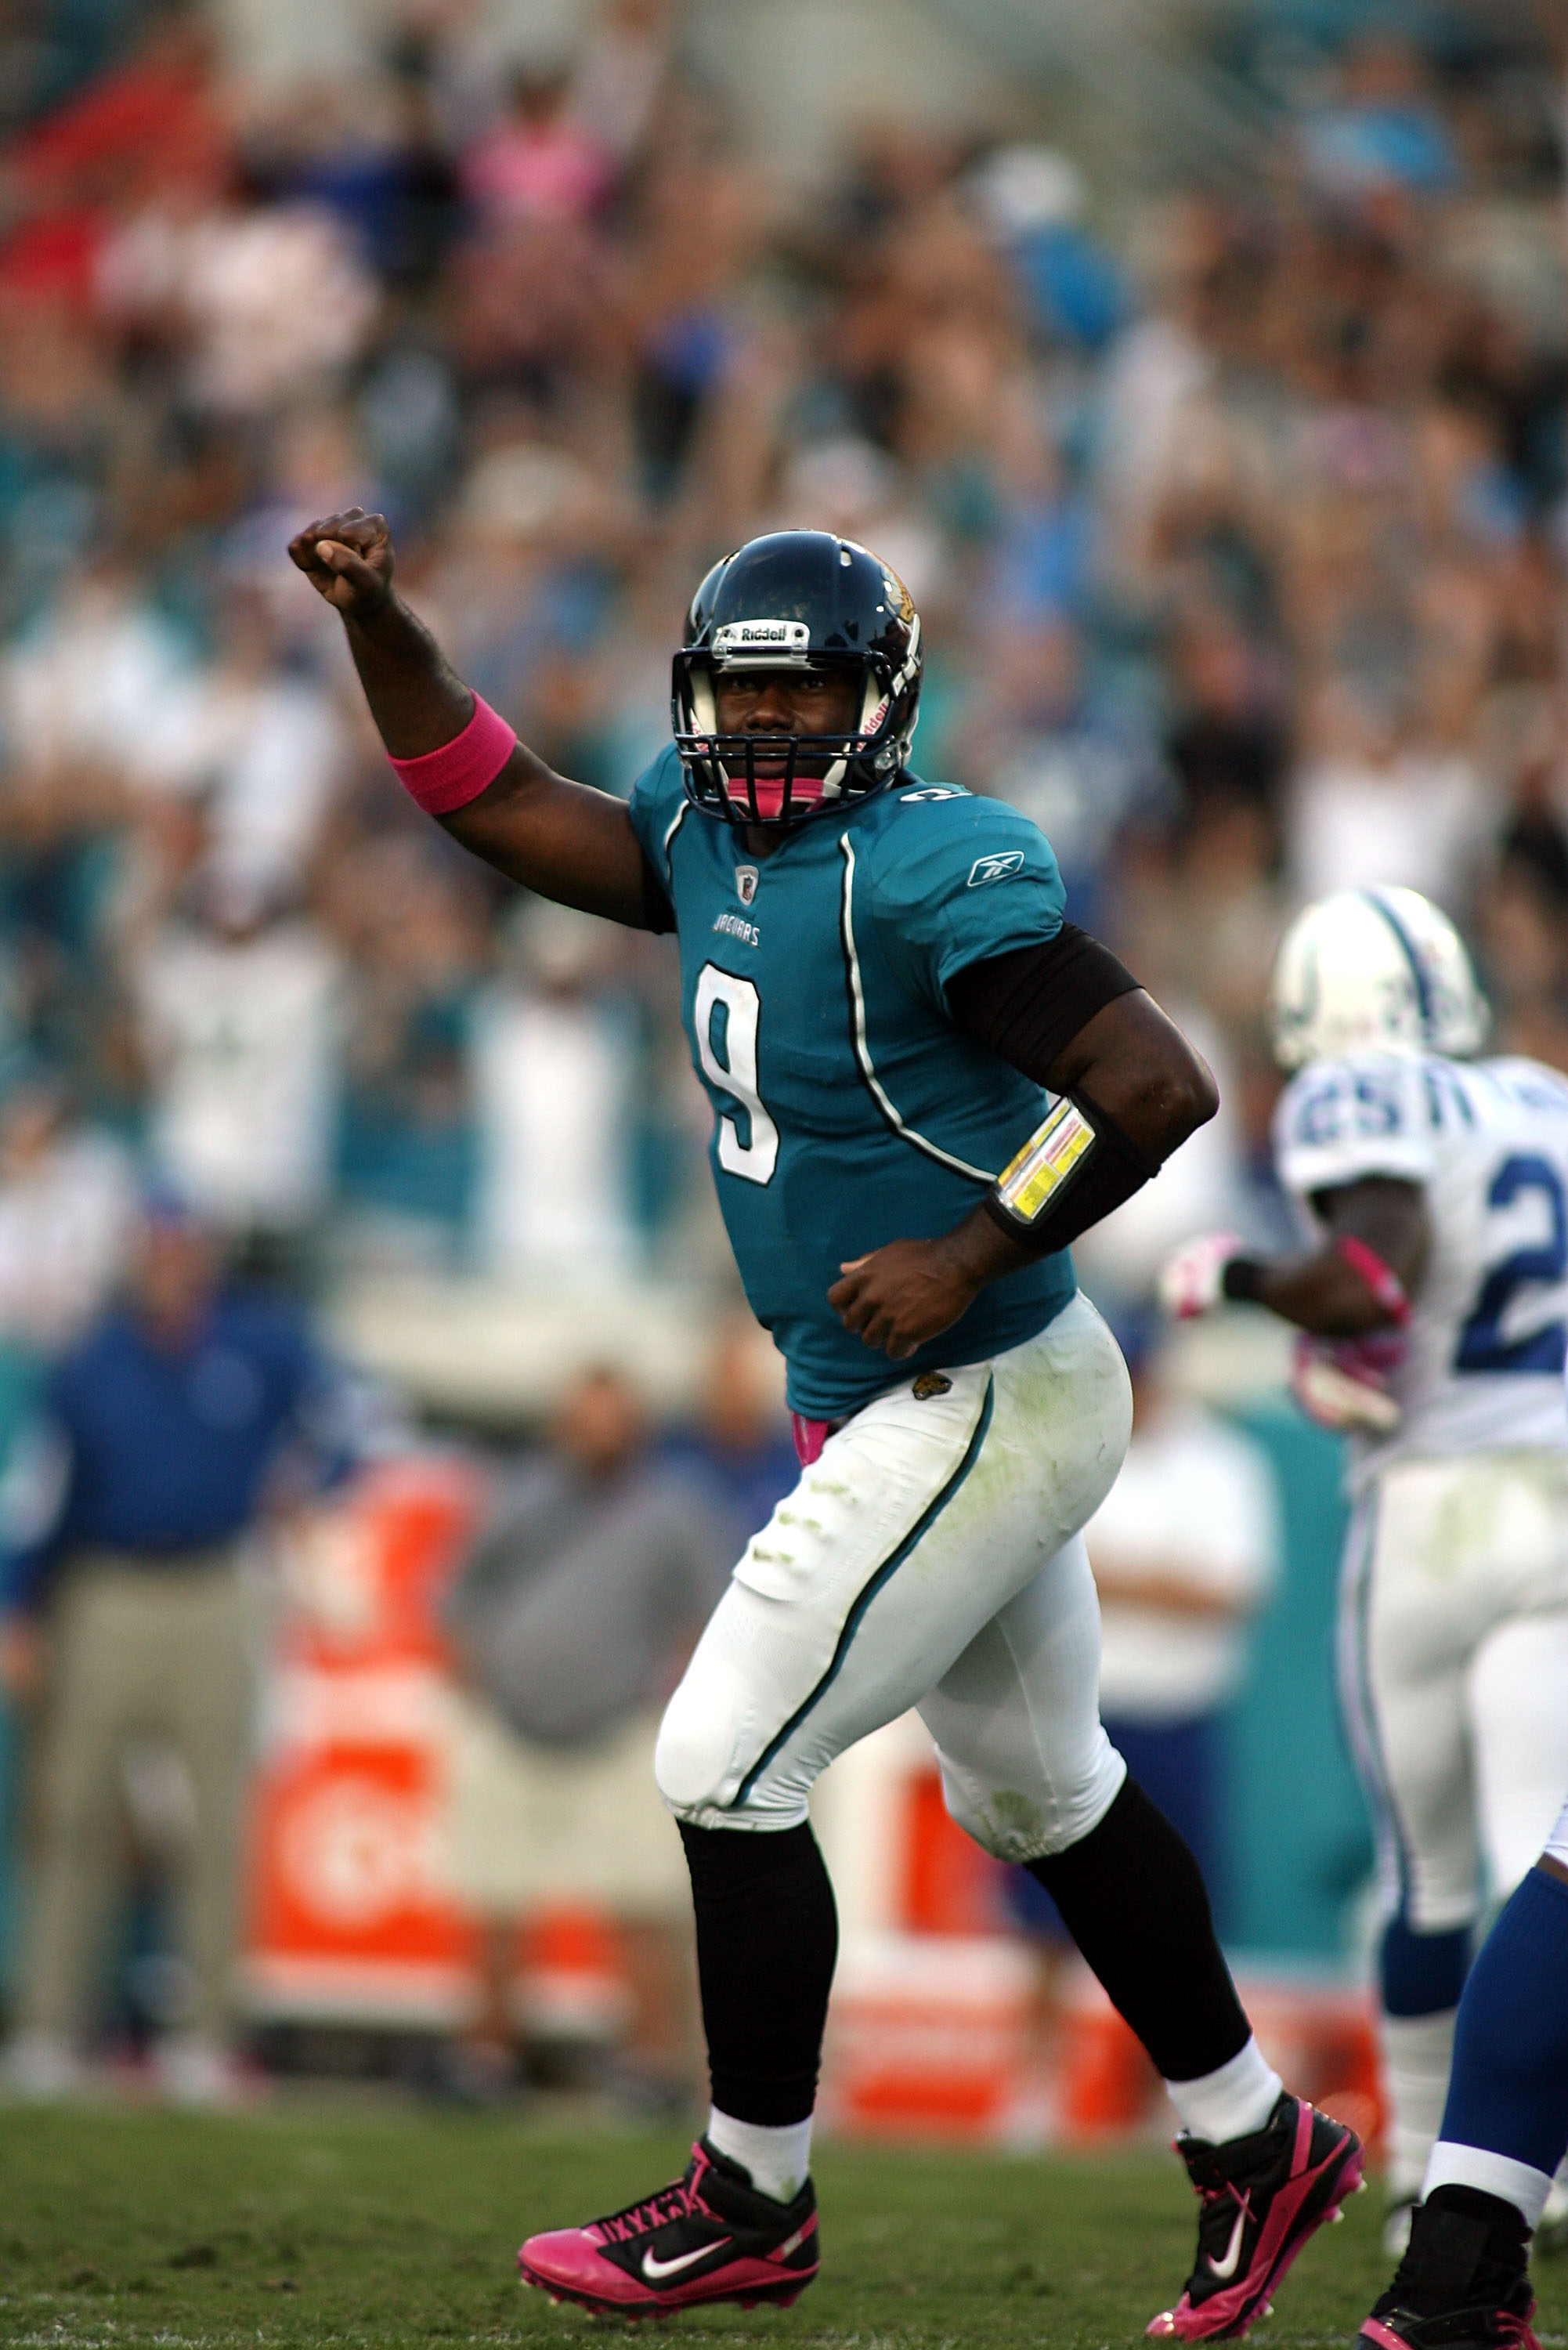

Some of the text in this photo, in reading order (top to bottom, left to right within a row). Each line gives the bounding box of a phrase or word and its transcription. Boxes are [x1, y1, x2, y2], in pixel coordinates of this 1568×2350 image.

[742, 627, 787, 641] Riddell
[713, 913, 761, 945] JAGUARS
[694, 960, 779, 1185] 9
